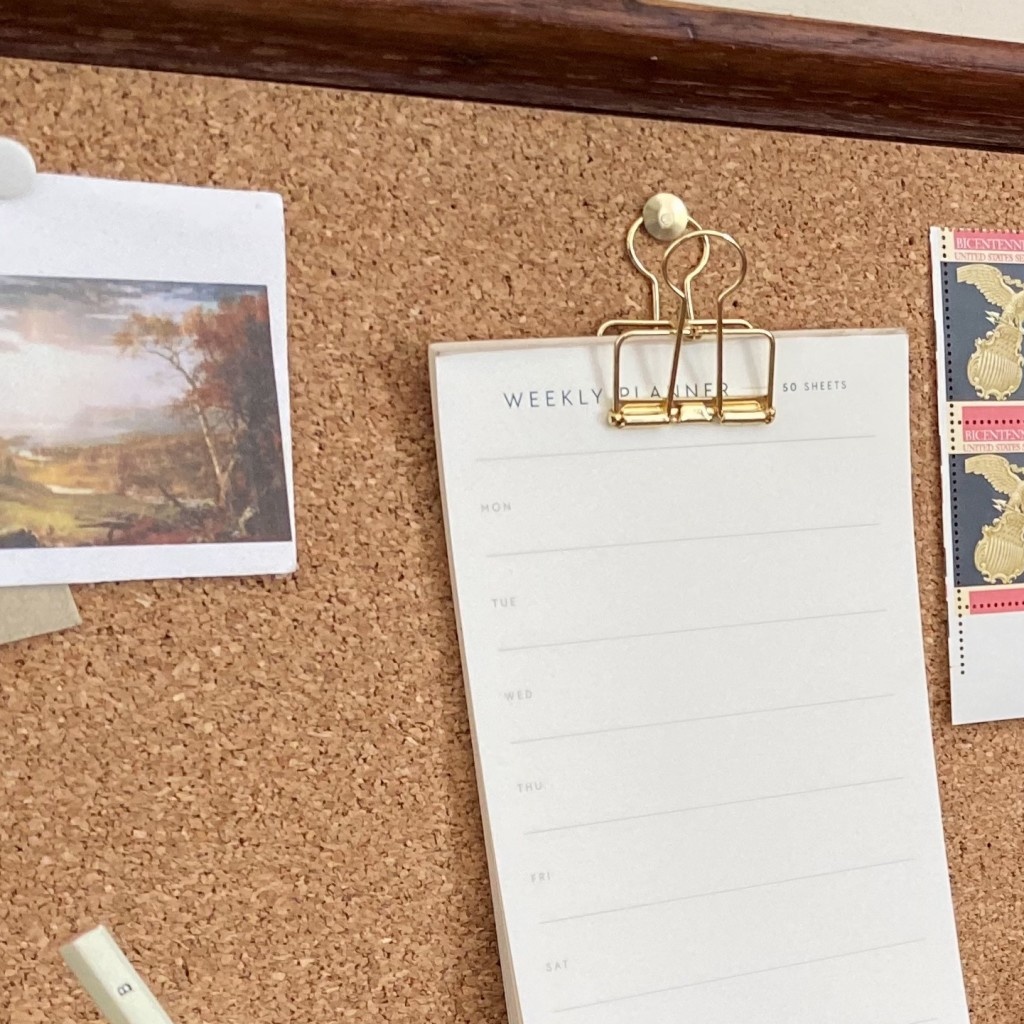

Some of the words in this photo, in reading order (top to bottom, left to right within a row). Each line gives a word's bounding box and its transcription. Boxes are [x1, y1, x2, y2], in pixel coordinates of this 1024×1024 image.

[955, 252, 986, 261] UNITED
[988, 253, 1013, 261] STATES
[503, 388, 603, 408] WEEKLY
[782, 382, 797, 392] 50
[804, 380, 847, 391] SHEETS
[963, 443, 993, 452] UNITED
[995, 443, 1021, 451] STATES
[481, 502, 511, 512] MON
[491, 597, 516, 608] TUE
[504, 690, 533, 701] WED
[517, 781, 543, 793] THU
[530, 872, 551, 884] FRI
[546, 960, 568, 972] SAT
